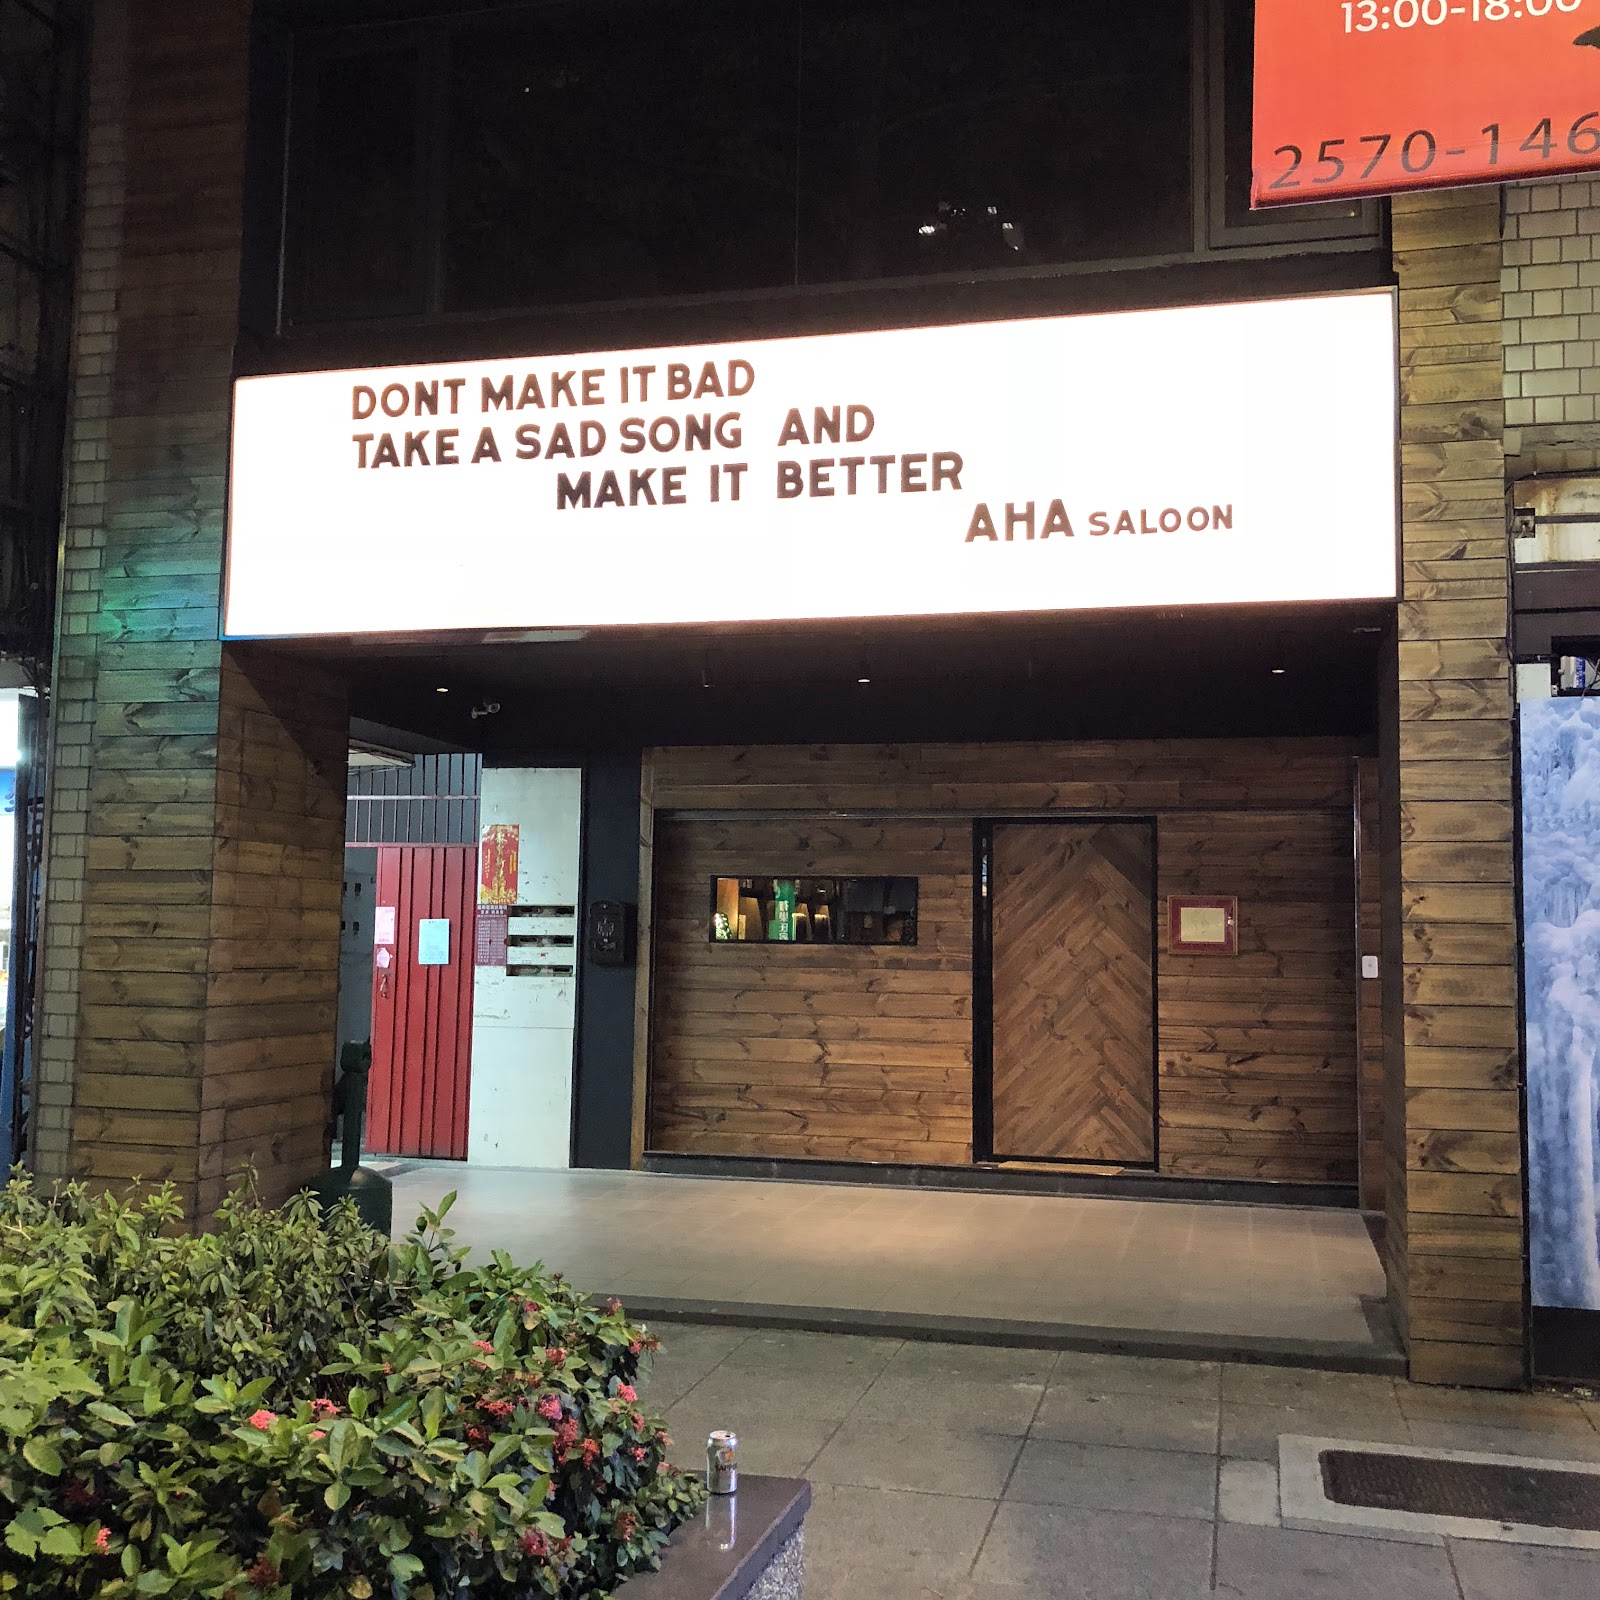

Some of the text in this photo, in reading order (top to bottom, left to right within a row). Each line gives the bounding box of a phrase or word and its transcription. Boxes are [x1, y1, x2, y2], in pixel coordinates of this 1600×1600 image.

[352, 359, 756, 420] DONT MAKE IT BAD
[352, 404, 875, 469] TAKE A SAD SONG AND
[556, 451, 964, 511] MAKE IT BETTER
[964, 498, 1233, 543] AHA SALOON
